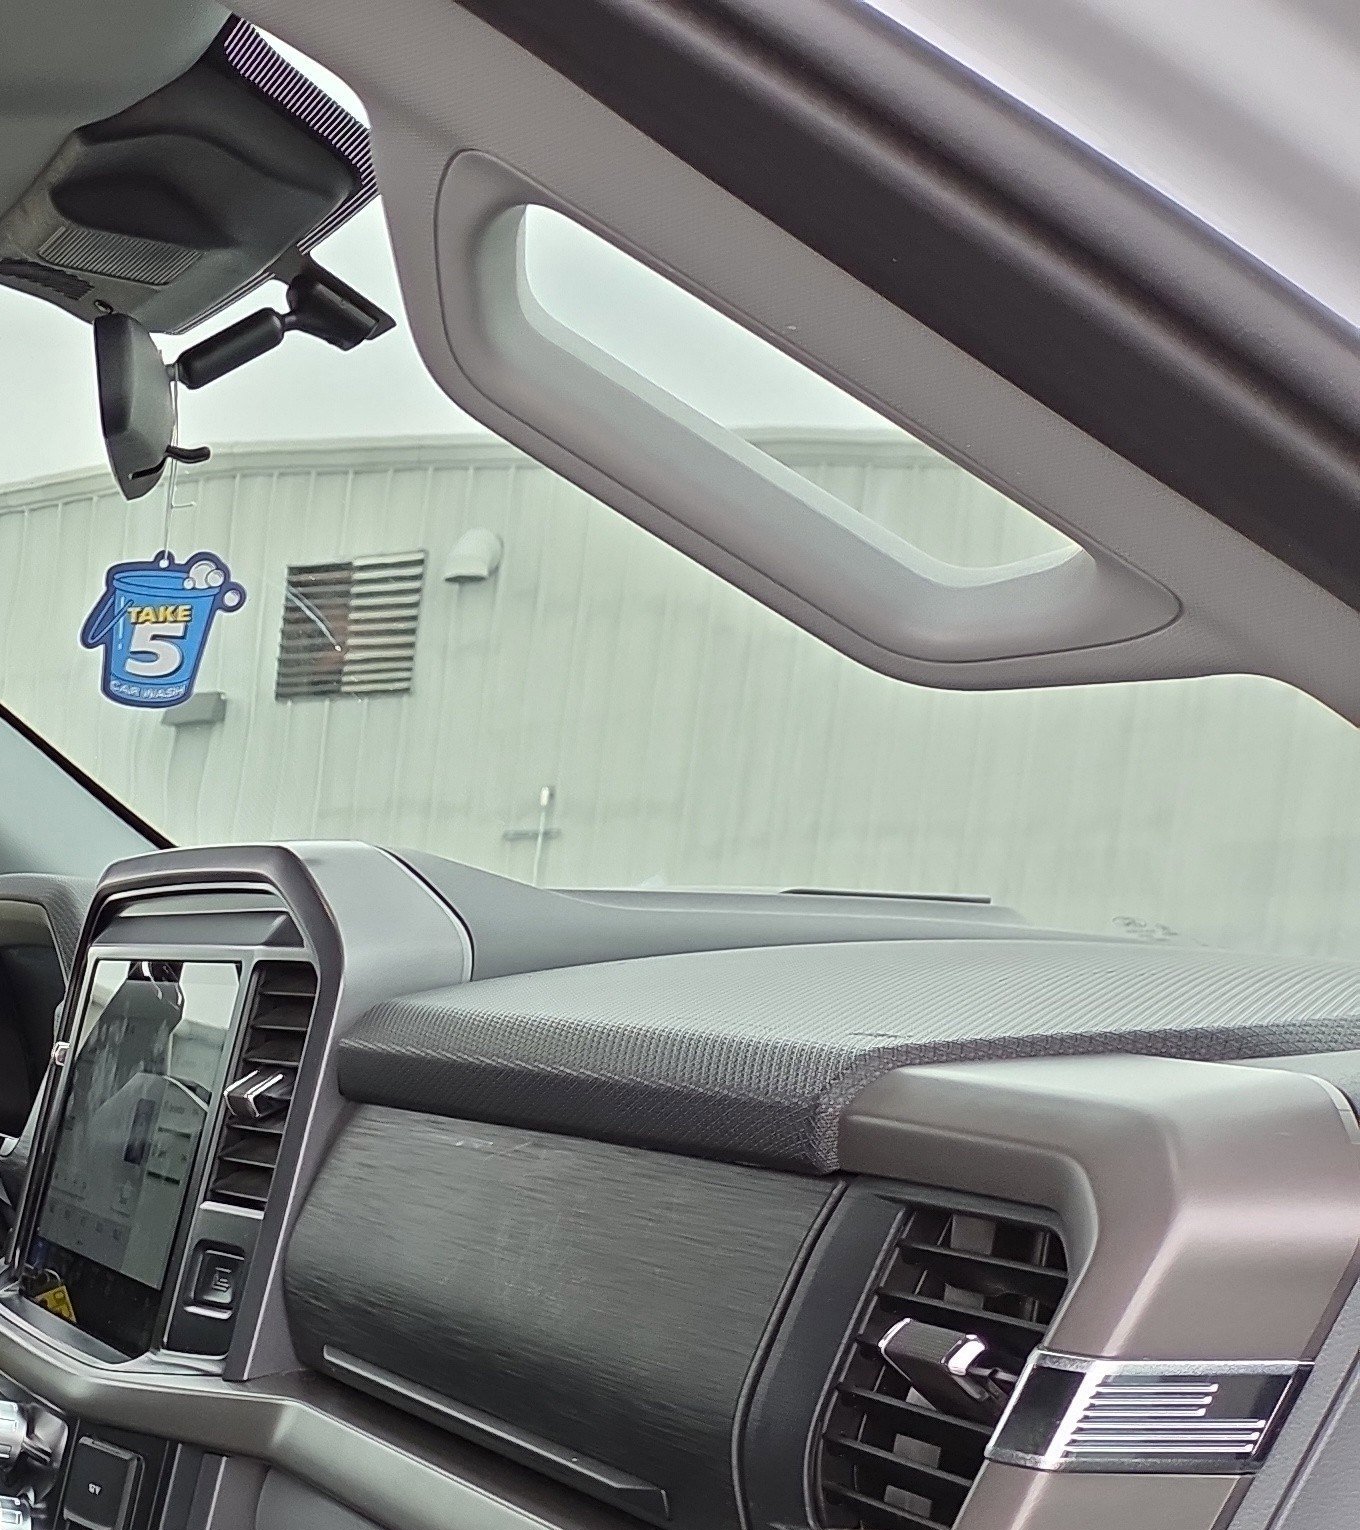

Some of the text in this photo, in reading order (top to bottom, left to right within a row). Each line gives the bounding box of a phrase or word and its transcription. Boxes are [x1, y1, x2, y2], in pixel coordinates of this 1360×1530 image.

[126, 603, 193, 625] TAKE
[124, 622, 188, 679] 5
[109, 680, 187, 701] CAR WASH
